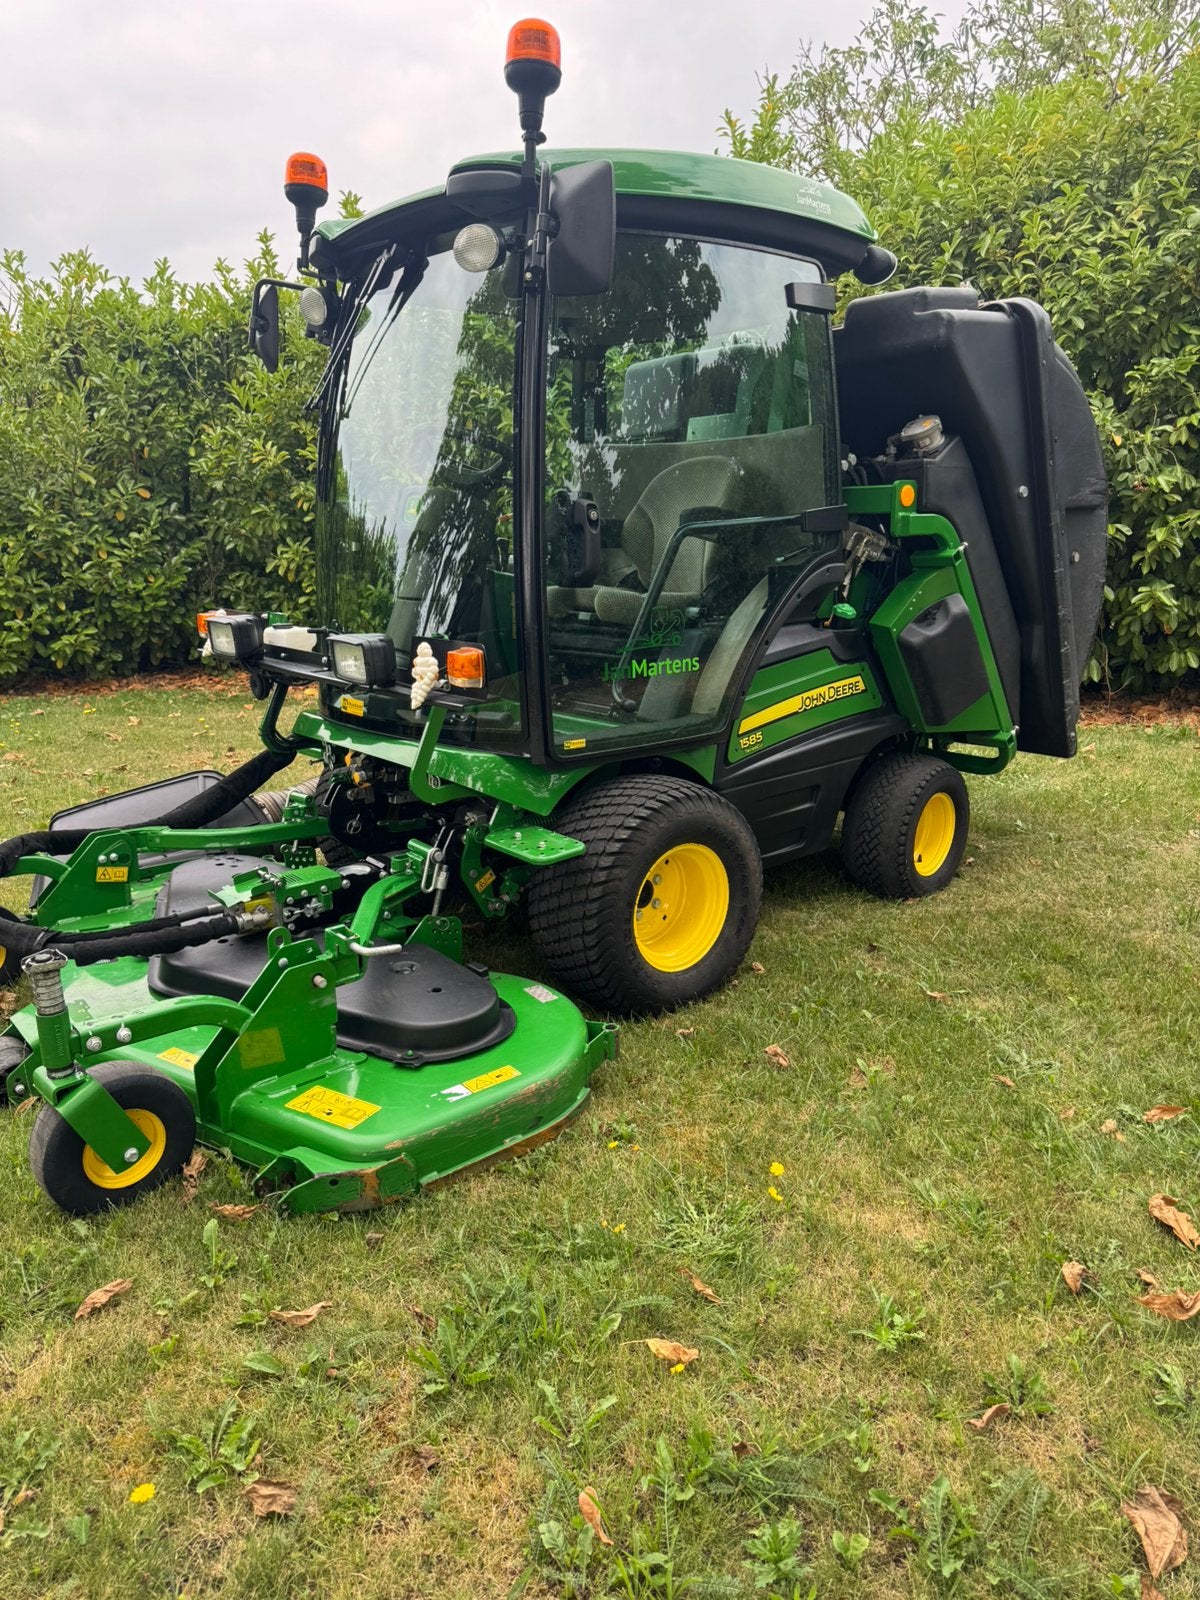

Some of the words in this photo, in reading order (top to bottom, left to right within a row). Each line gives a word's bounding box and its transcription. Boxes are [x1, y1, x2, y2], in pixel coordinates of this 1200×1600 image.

[798, 691, 827, 712] JOHN
[827, 680, 860, 701] DEERE
[739, 731, 763, 749] 1585
